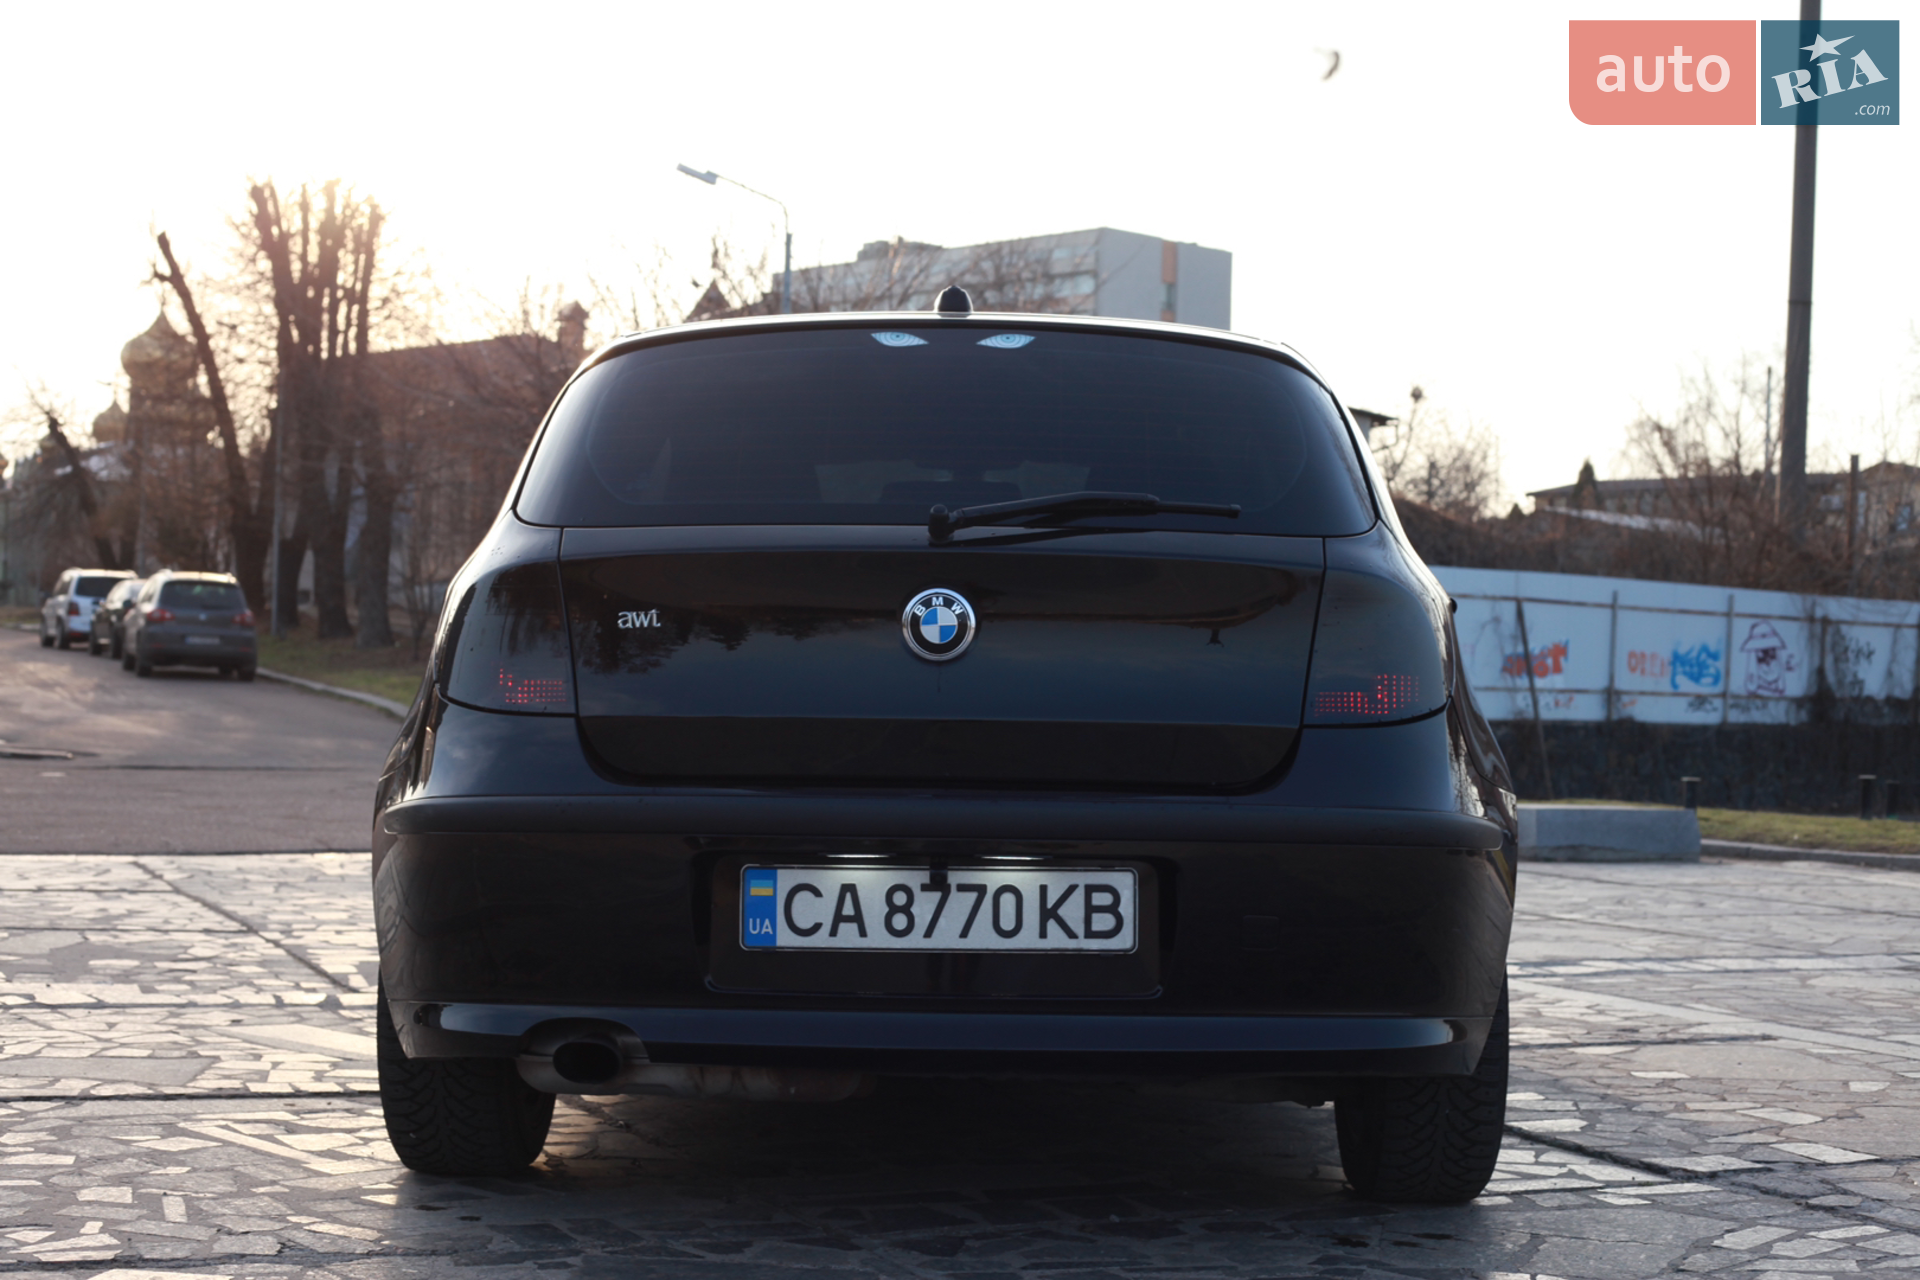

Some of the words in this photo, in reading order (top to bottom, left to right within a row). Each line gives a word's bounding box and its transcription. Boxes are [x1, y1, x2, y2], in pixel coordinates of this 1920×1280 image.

[914, 596, 963, 616] BMW
[785, 883, 868, 937] CA
[884, 883, 1023, 939] 8770
[1038, 884, 1124, 939] KB
[748, 918, 773, 935] UA
